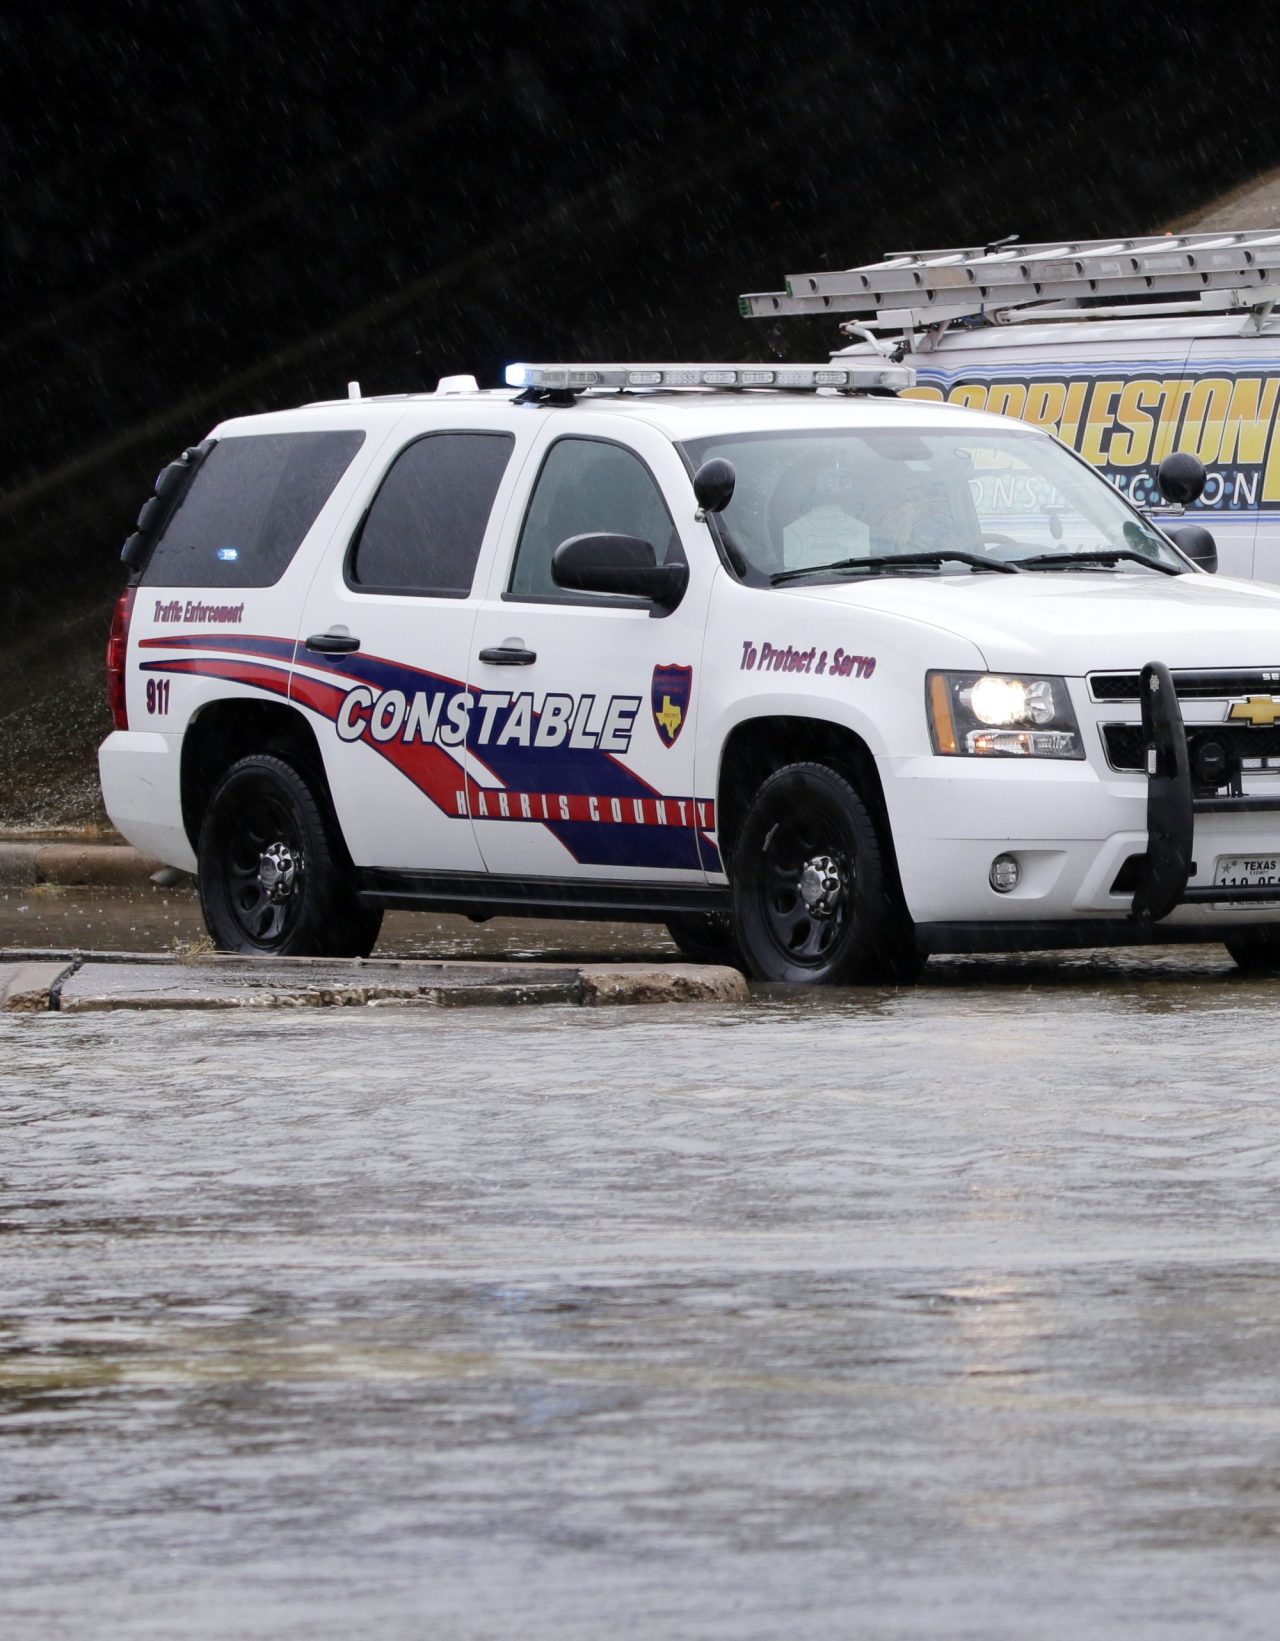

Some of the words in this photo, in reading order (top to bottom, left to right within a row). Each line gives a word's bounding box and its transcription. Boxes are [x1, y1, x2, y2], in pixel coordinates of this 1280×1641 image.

[154, 600, 183, 623] Traffic
[183, 600, 245, 623] Enforcement
[740, 640, 758, 671] To
[757, 642, 817, 674] Protect
[815, 650, 828, 675] &
[829, 647, 877, 680] Serve
[146, 678, 170, 715] 911
[336, 684, 643, 754] CONSTABLE
[456, 790, 570, 820] HARRIS
[589, 796, 707, 828] COUNTY
[1244, 860, 1277, 871] TEXAS
